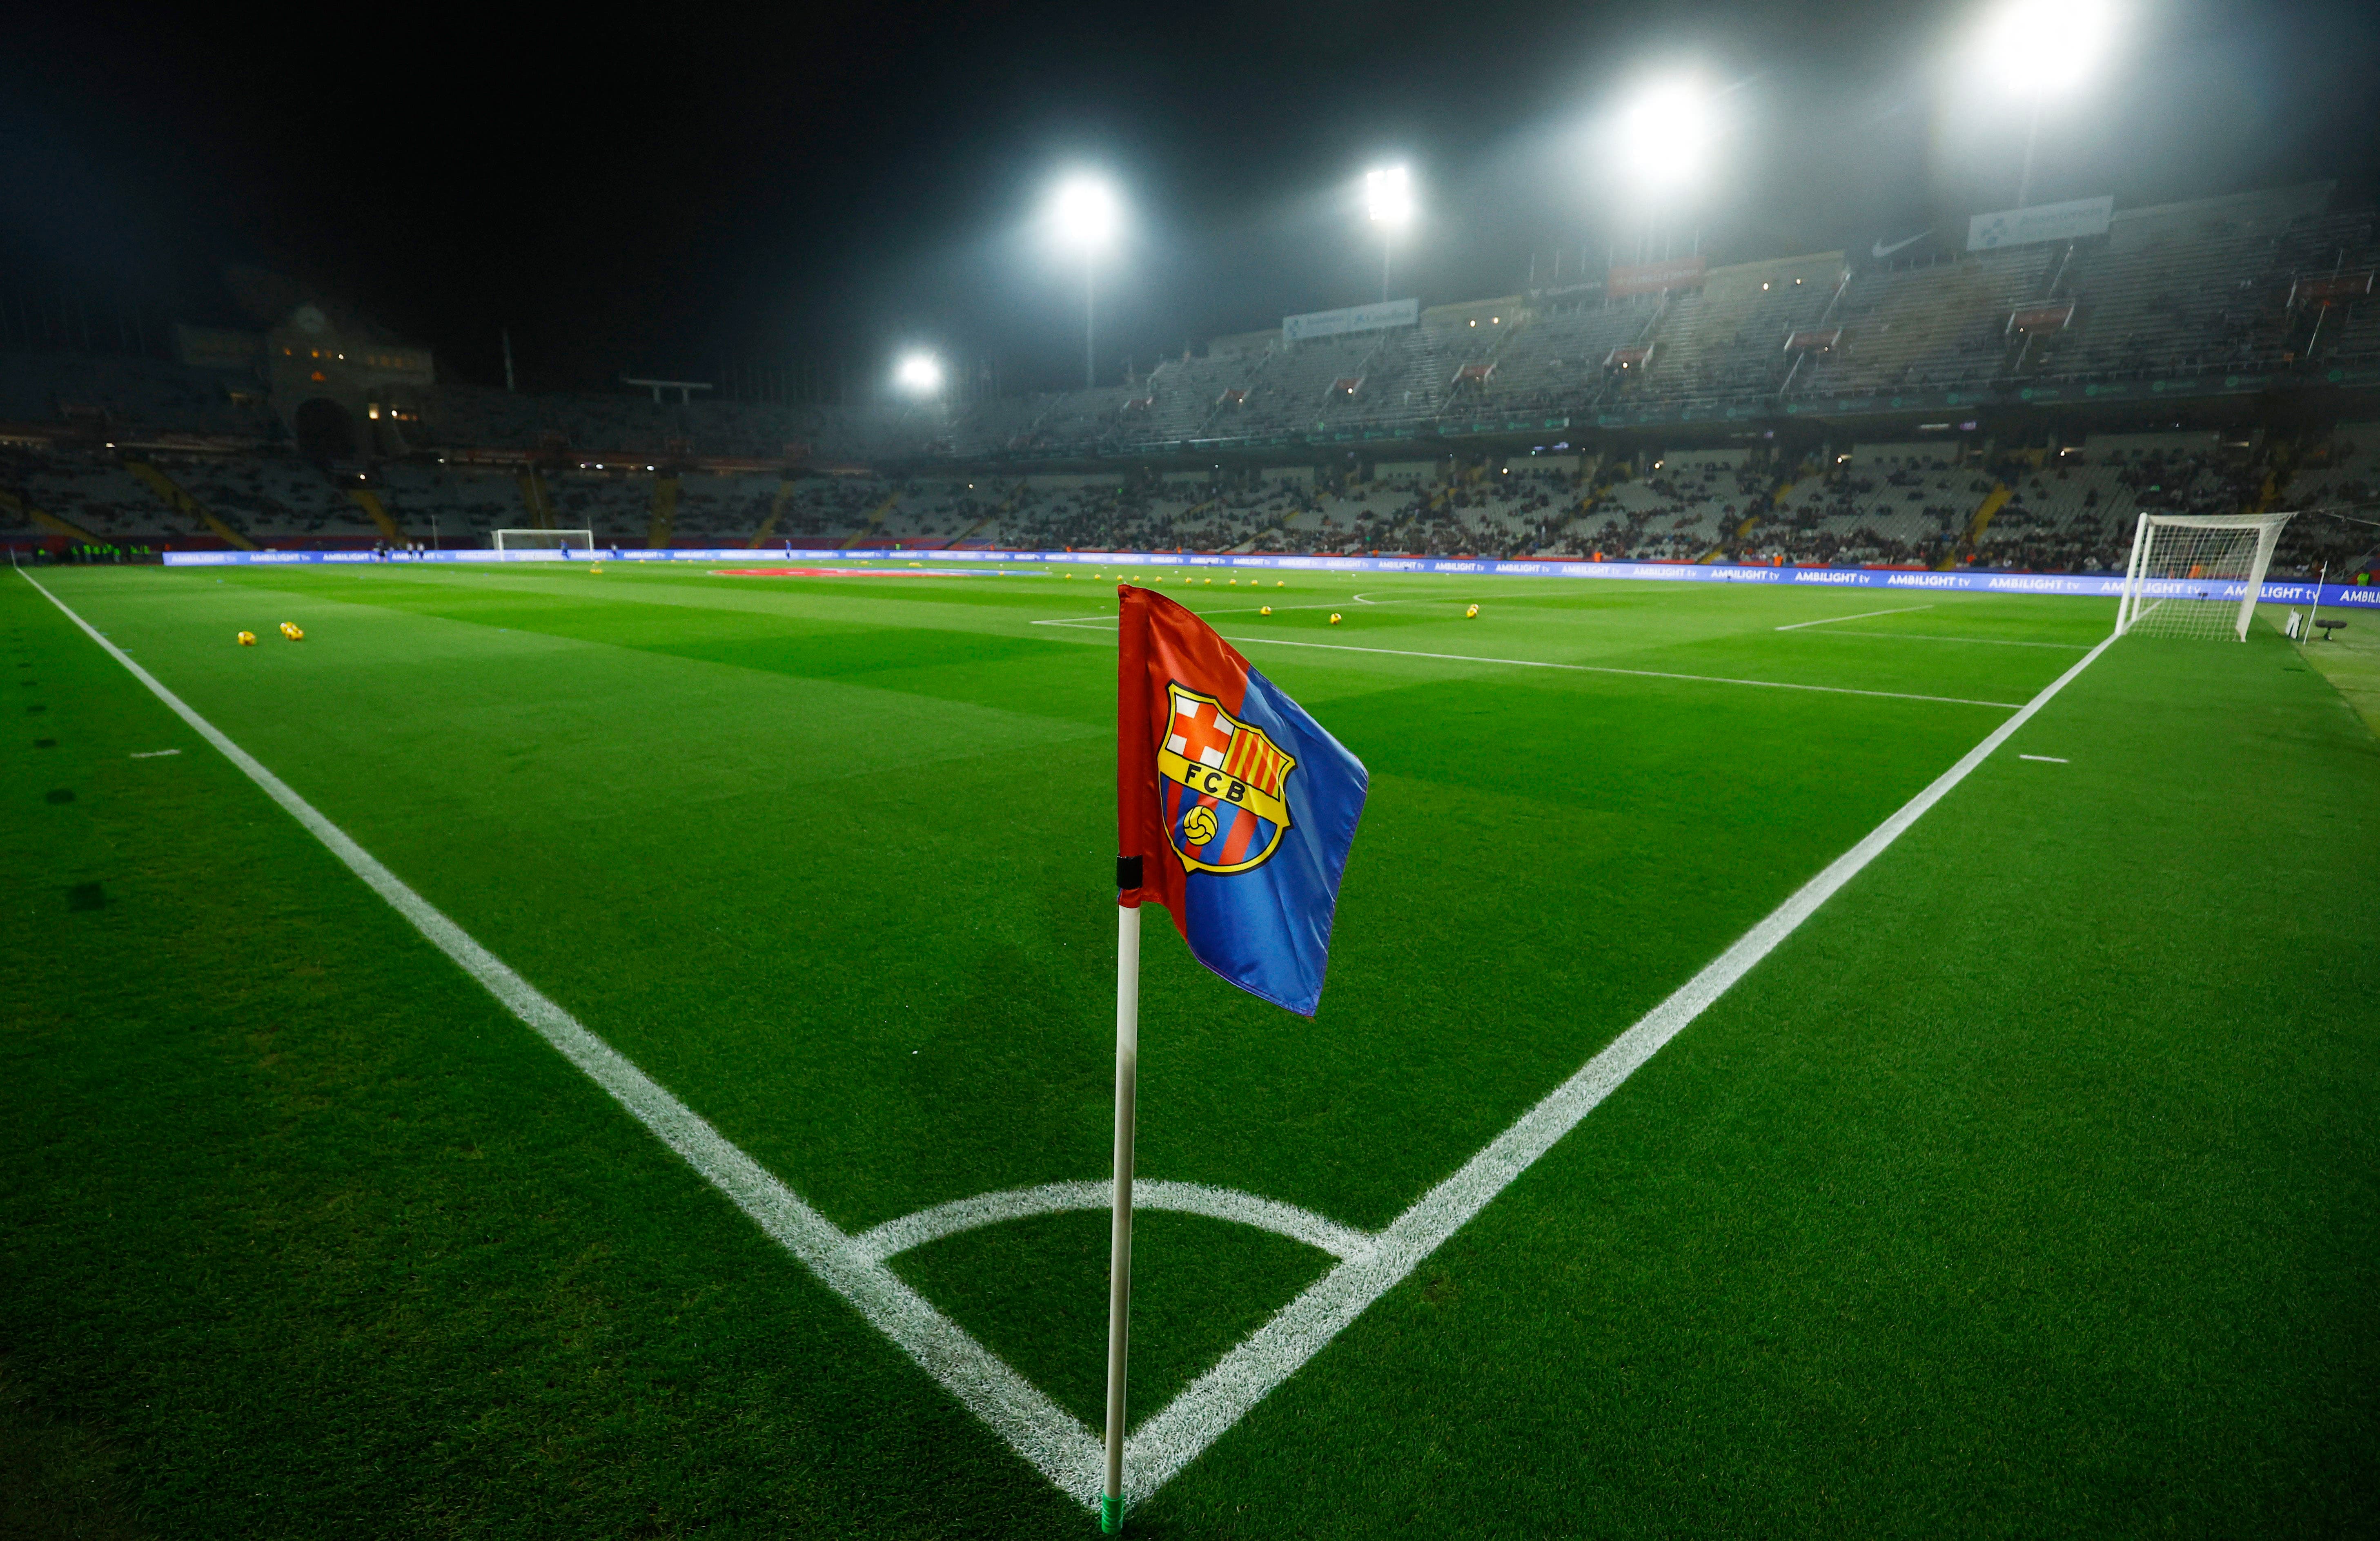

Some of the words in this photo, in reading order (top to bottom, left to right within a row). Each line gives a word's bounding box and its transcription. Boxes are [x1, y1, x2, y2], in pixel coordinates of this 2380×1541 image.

[1435, 562, 1476, 571] AMBILIGHT
[1496, 564, 1541, 572] AMBILIGHT
[1562, 566, 1610, 574] AMBILIGHT
[1633, 566, 1685, 577] AMBILIGHT
[1687, 569, 1697, 577] tv
[1711, 569, 1768, 580] AMBILIGHT
[1769, 572, 1780, 580] tv
[1795, 571, 1857, 583] AMBILIGHT
[1859, 575, 1870, 584] tv
[1888, 574, 1956, 587] AMBILIGHT
[1959, 577, 1971, 587] tv
[1989, 578, 2064, 589] AMBILIGHT
[2067, 582, 2080, 590] tv
[2188, 584, 2202, 594] tv
[2340, 590, 2380, 603] AMBILI
[1185, 764, 1245, 802] FCB
